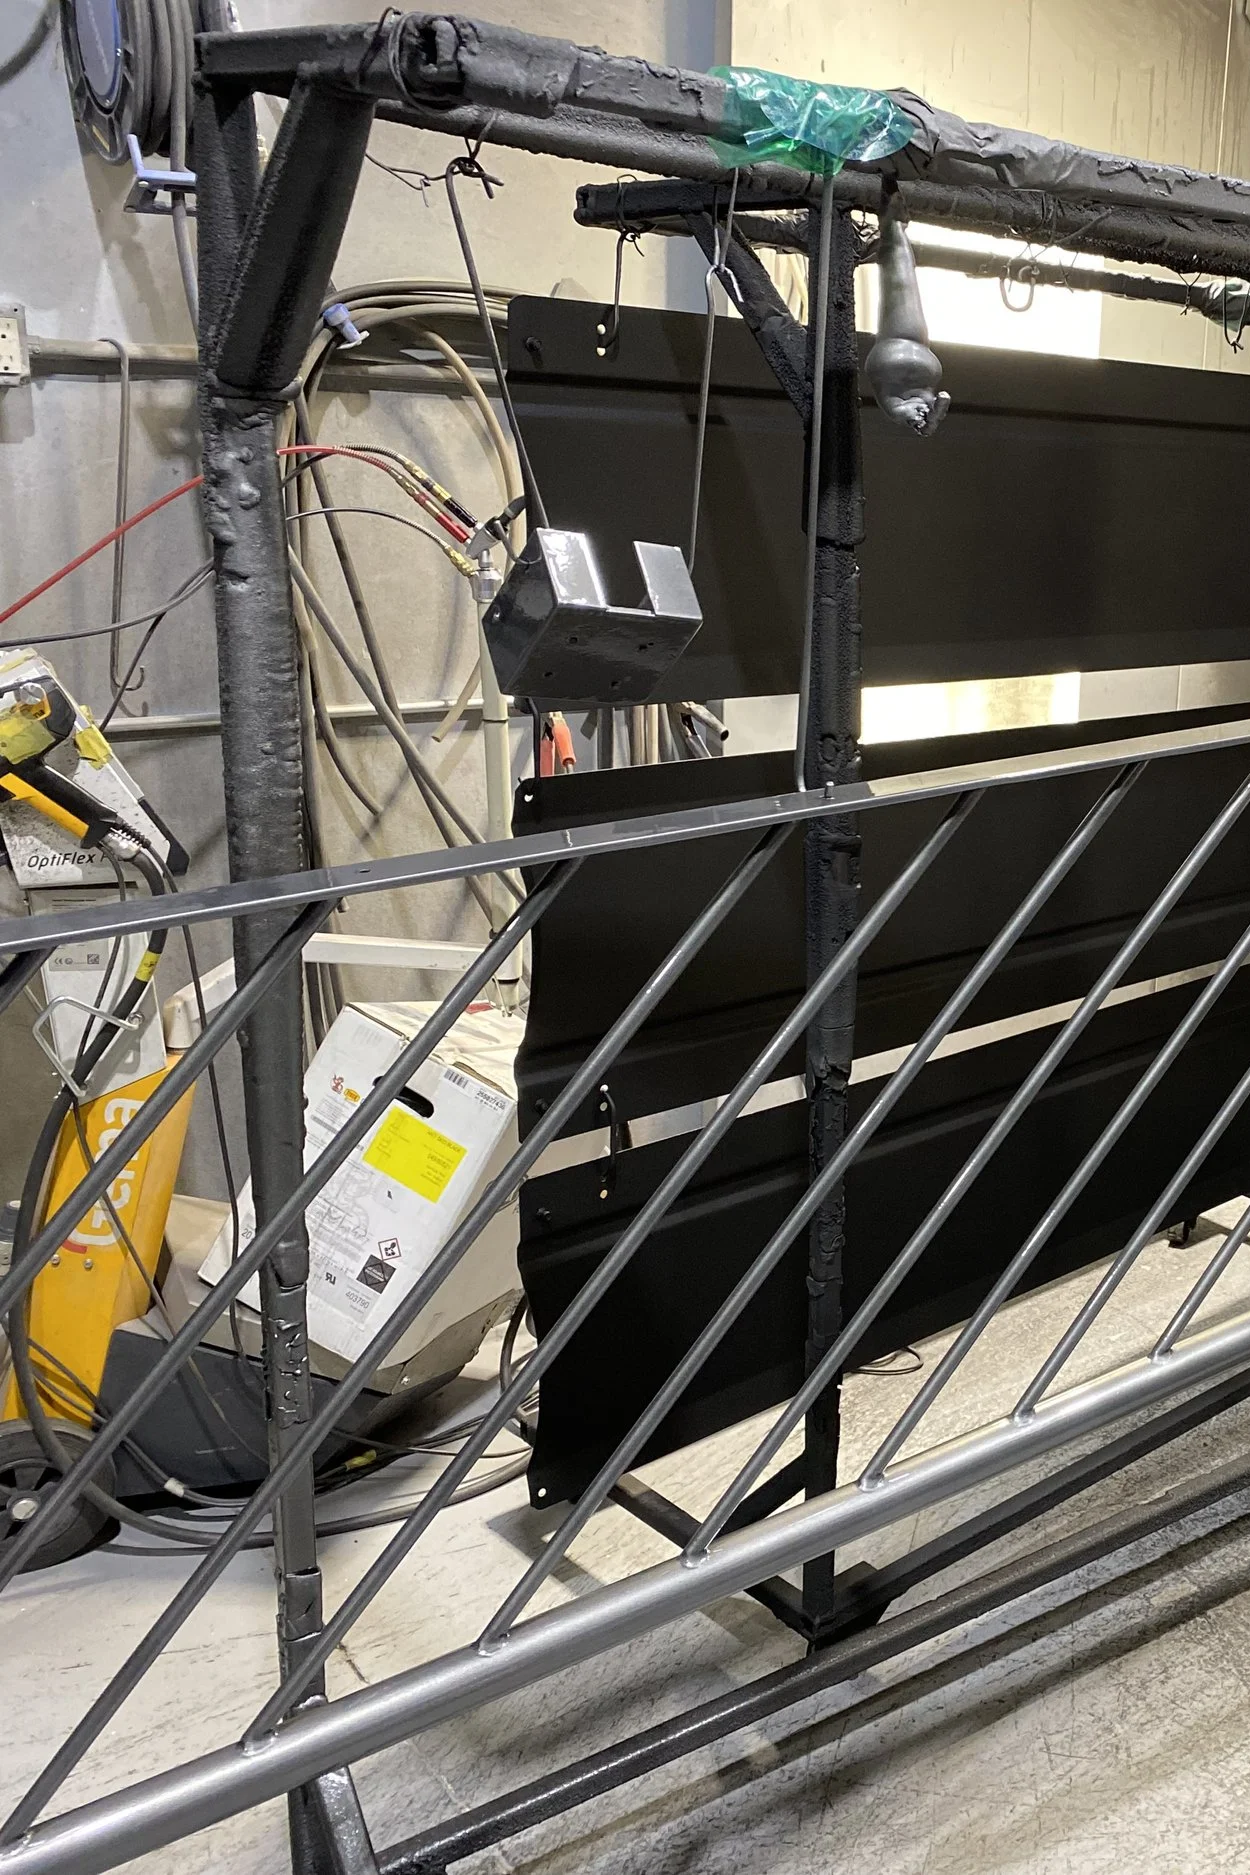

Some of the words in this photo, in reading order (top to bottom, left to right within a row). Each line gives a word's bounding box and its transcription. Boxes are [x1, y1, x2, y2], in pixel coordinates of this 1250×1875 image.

[27, 852, 96, 871] OptiFlex
[241, 1228, 253, 1240] 20
[345, 1290, 370, 1309] 403790
